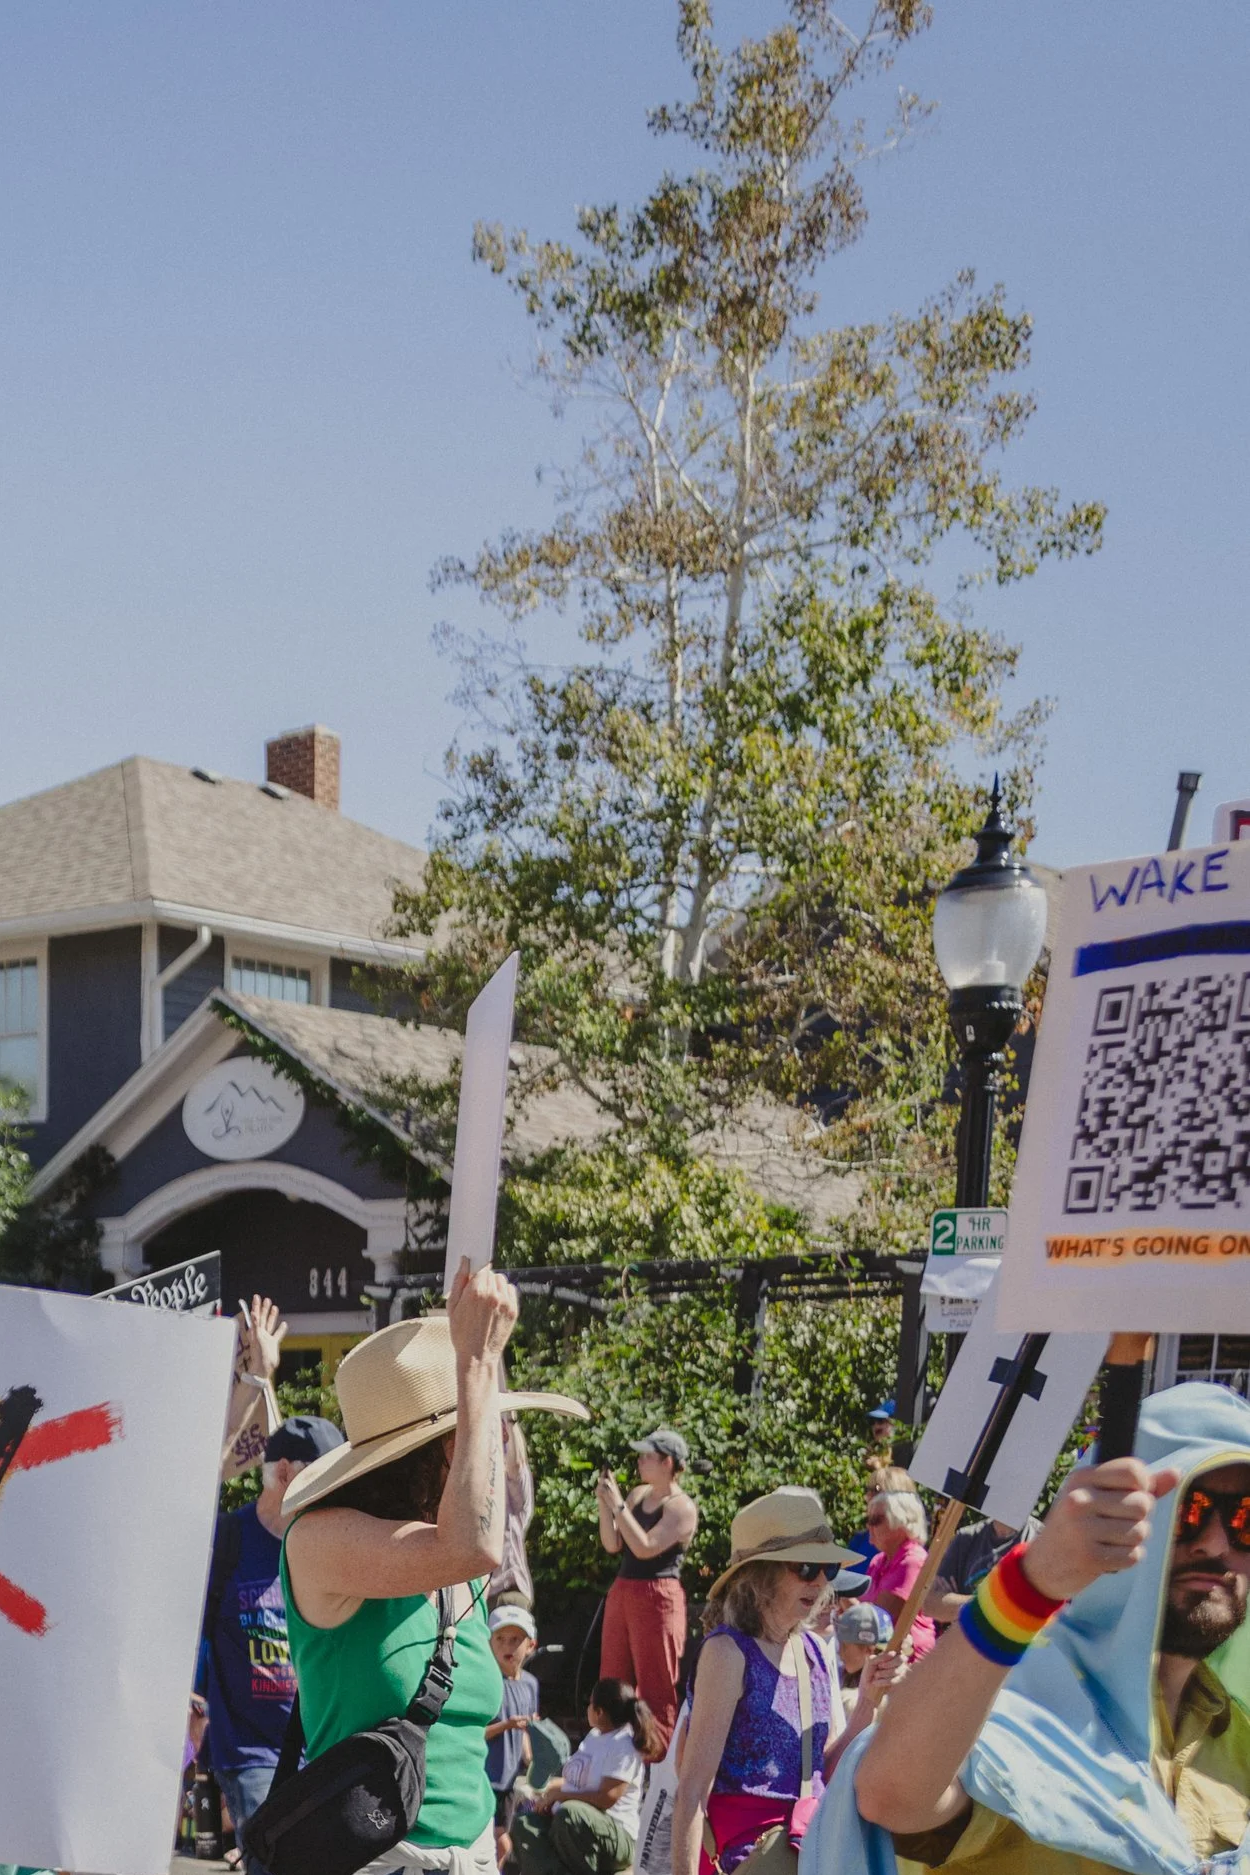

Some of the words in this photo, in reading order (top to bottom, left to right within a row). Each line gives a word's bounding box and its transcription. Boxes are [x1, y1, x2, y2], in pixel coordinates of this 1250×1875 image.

[1089, 849, 1229, 913] WAKE
[933, 1219, 955, 1250] 2
[970, 1217, 991, 1232] HR
[956, 1235, 1004, 1250] PARKING
[1045, 1237, 1125, 1258] WHAT'S
[1133, 1235, 1210, 1256] GOING
[131, 1265, 209, 1312] People
[308, 1266, 348, 1299] 844
[248, 1639, 290, 1665] LOV
